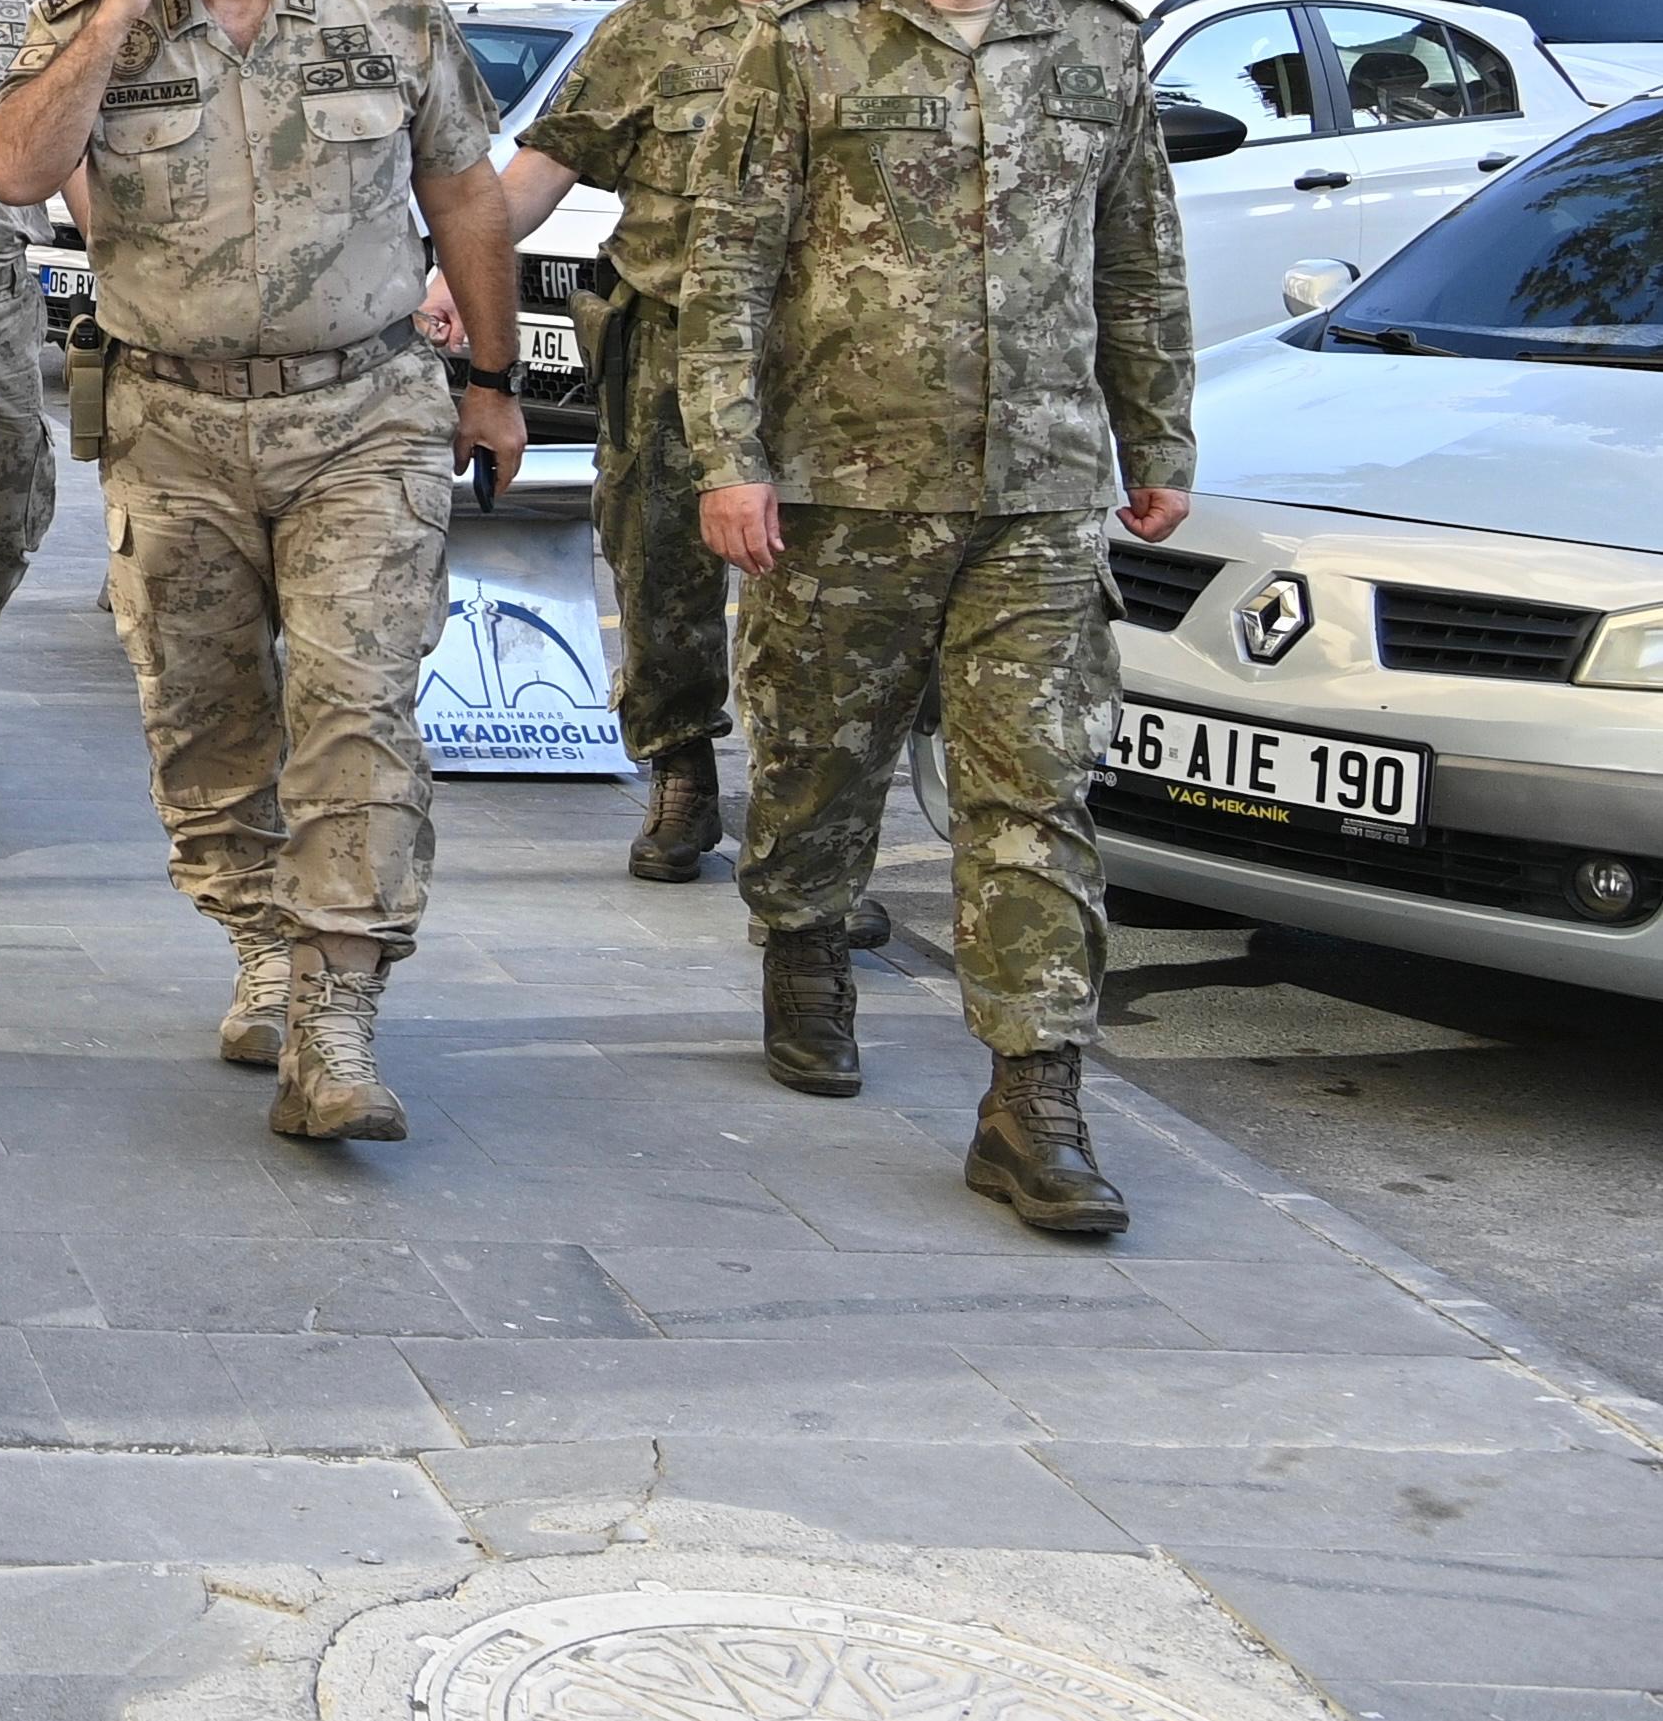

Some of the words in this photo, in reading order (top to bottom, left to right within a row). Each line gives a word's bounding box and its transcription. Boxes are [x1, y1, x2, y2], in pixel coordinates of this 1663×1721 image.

[105, 84, 194, 106] GEMALMAZ
[50, 271, 68, 294] 06
[540, 260, 580, 299] FIAT
[532, 330, 569, 361] AGL
[1110, 708, 1164, 770] 46
[1186, 723, 1280, 794] AIE
[1310, 745, 1404, 816] 190
[1166, 784, 1207, 808] VAG
[1211, 796, 1291, 824] MEKANİK
